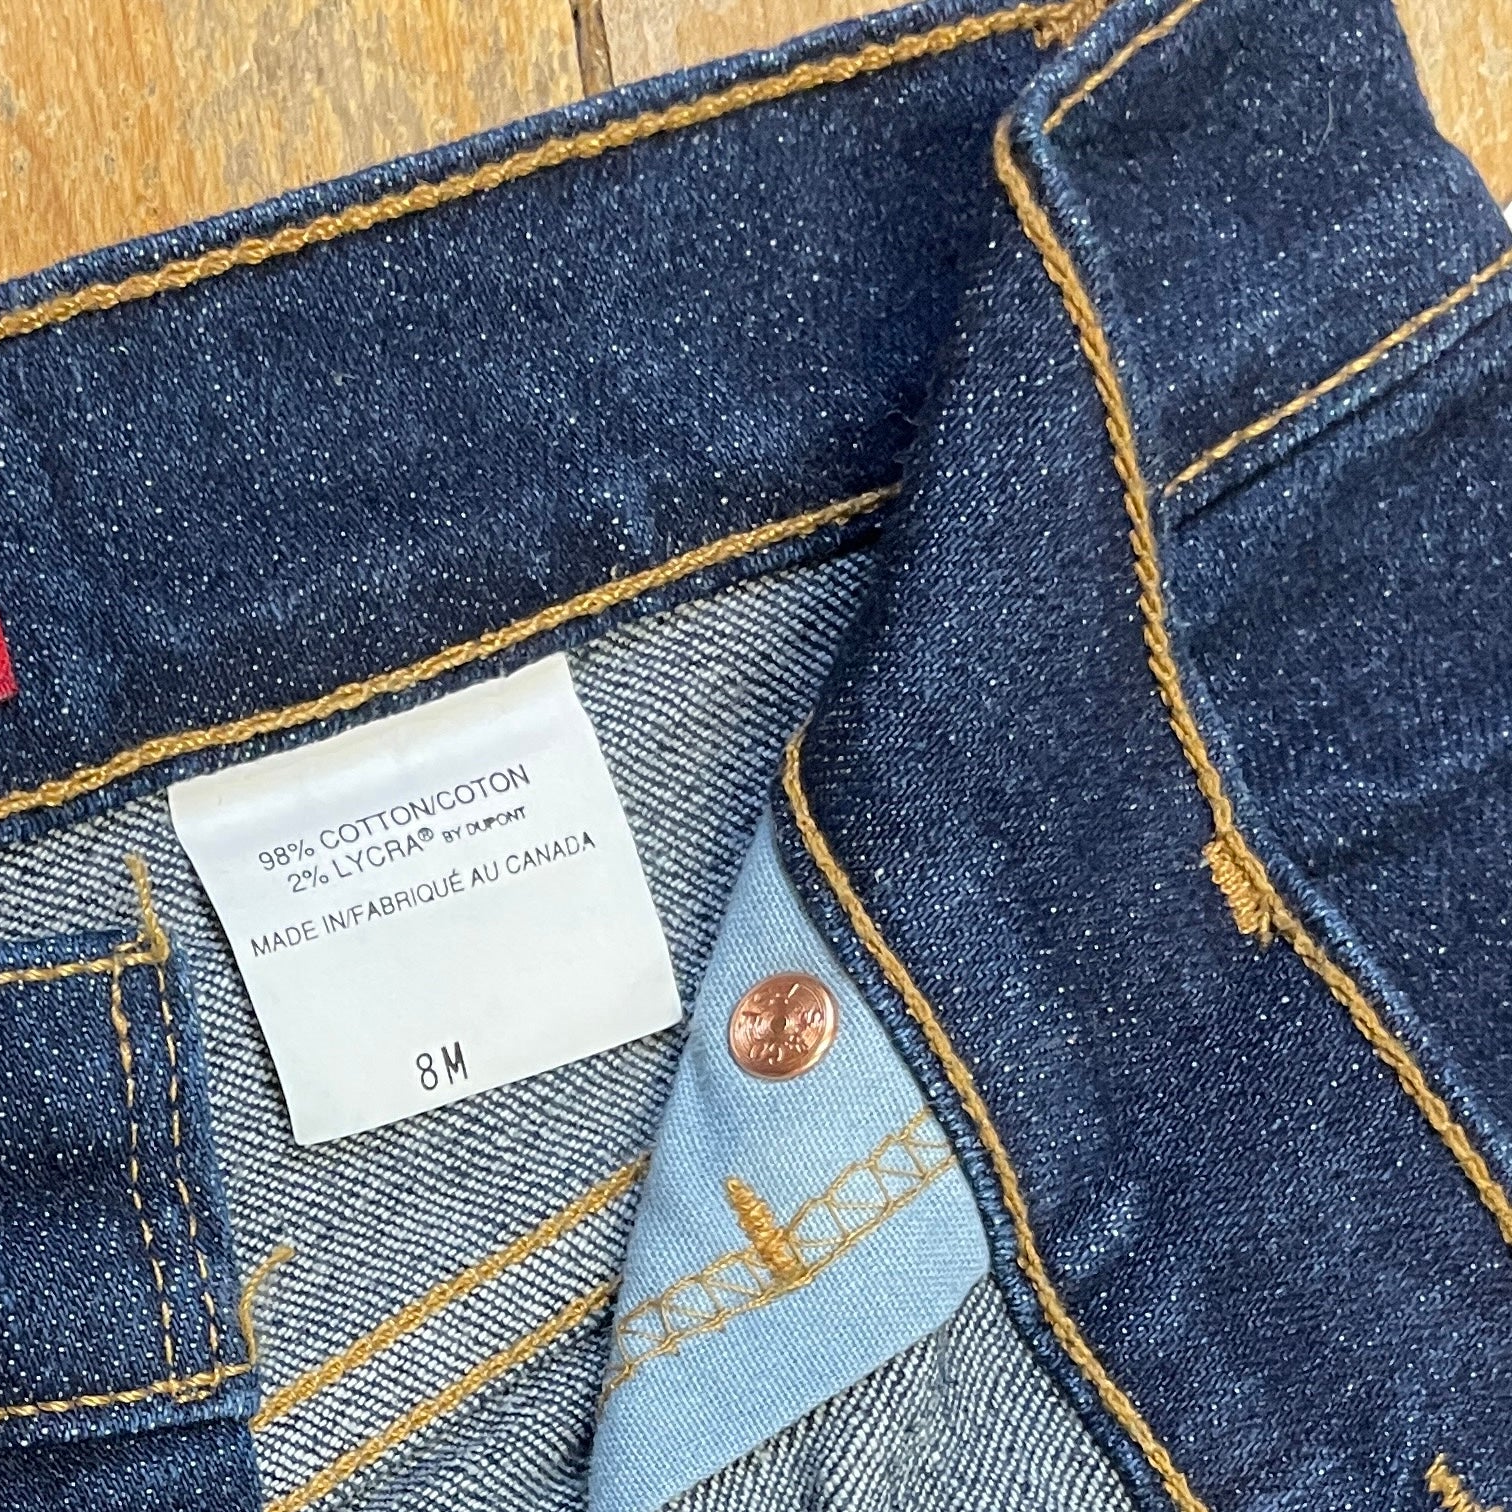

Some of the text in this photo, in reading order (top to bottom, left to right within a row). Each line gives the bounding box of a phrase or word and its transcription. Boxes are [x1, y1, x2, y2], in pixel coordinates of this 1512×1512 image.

[258, 763, 531, 871] 98% COTTON/COTON
[287, 865, 330, 893] 2%
[441, 827, 463, 844] BY
[466, 805, 528, 836] DUPONT
[250, 831, 597, 957] MADE IN/FABRIQUÉ AU CANADA
